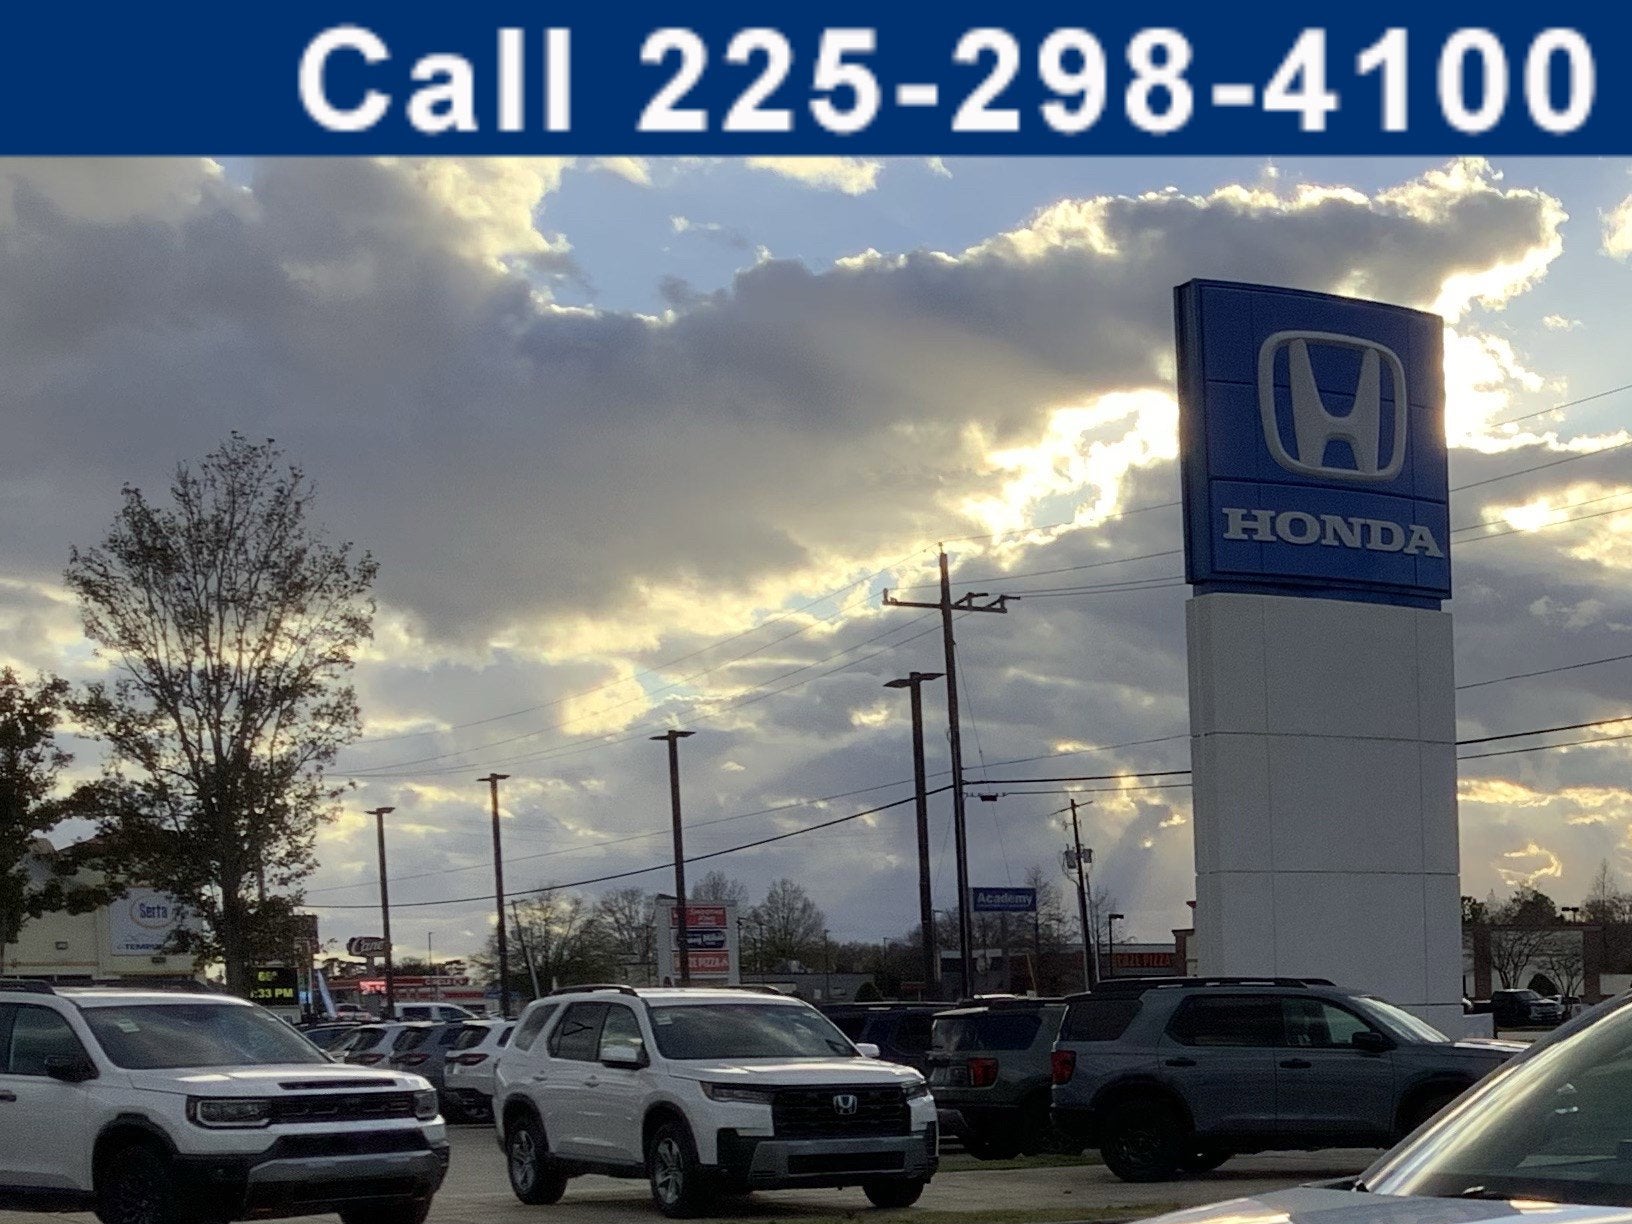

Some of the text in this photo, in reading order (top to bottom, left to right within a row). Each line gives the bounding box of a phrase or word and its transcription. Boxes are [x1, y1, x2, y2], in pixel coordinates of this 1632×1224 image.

[1222, 508, 1443, 557] HONDA
[977, 892, 1033, 906] Academy
[140, 903, 168, 919] Serta
[699, 956, 721, 969] PIZZA
[274, 988, 294, 998] PM
